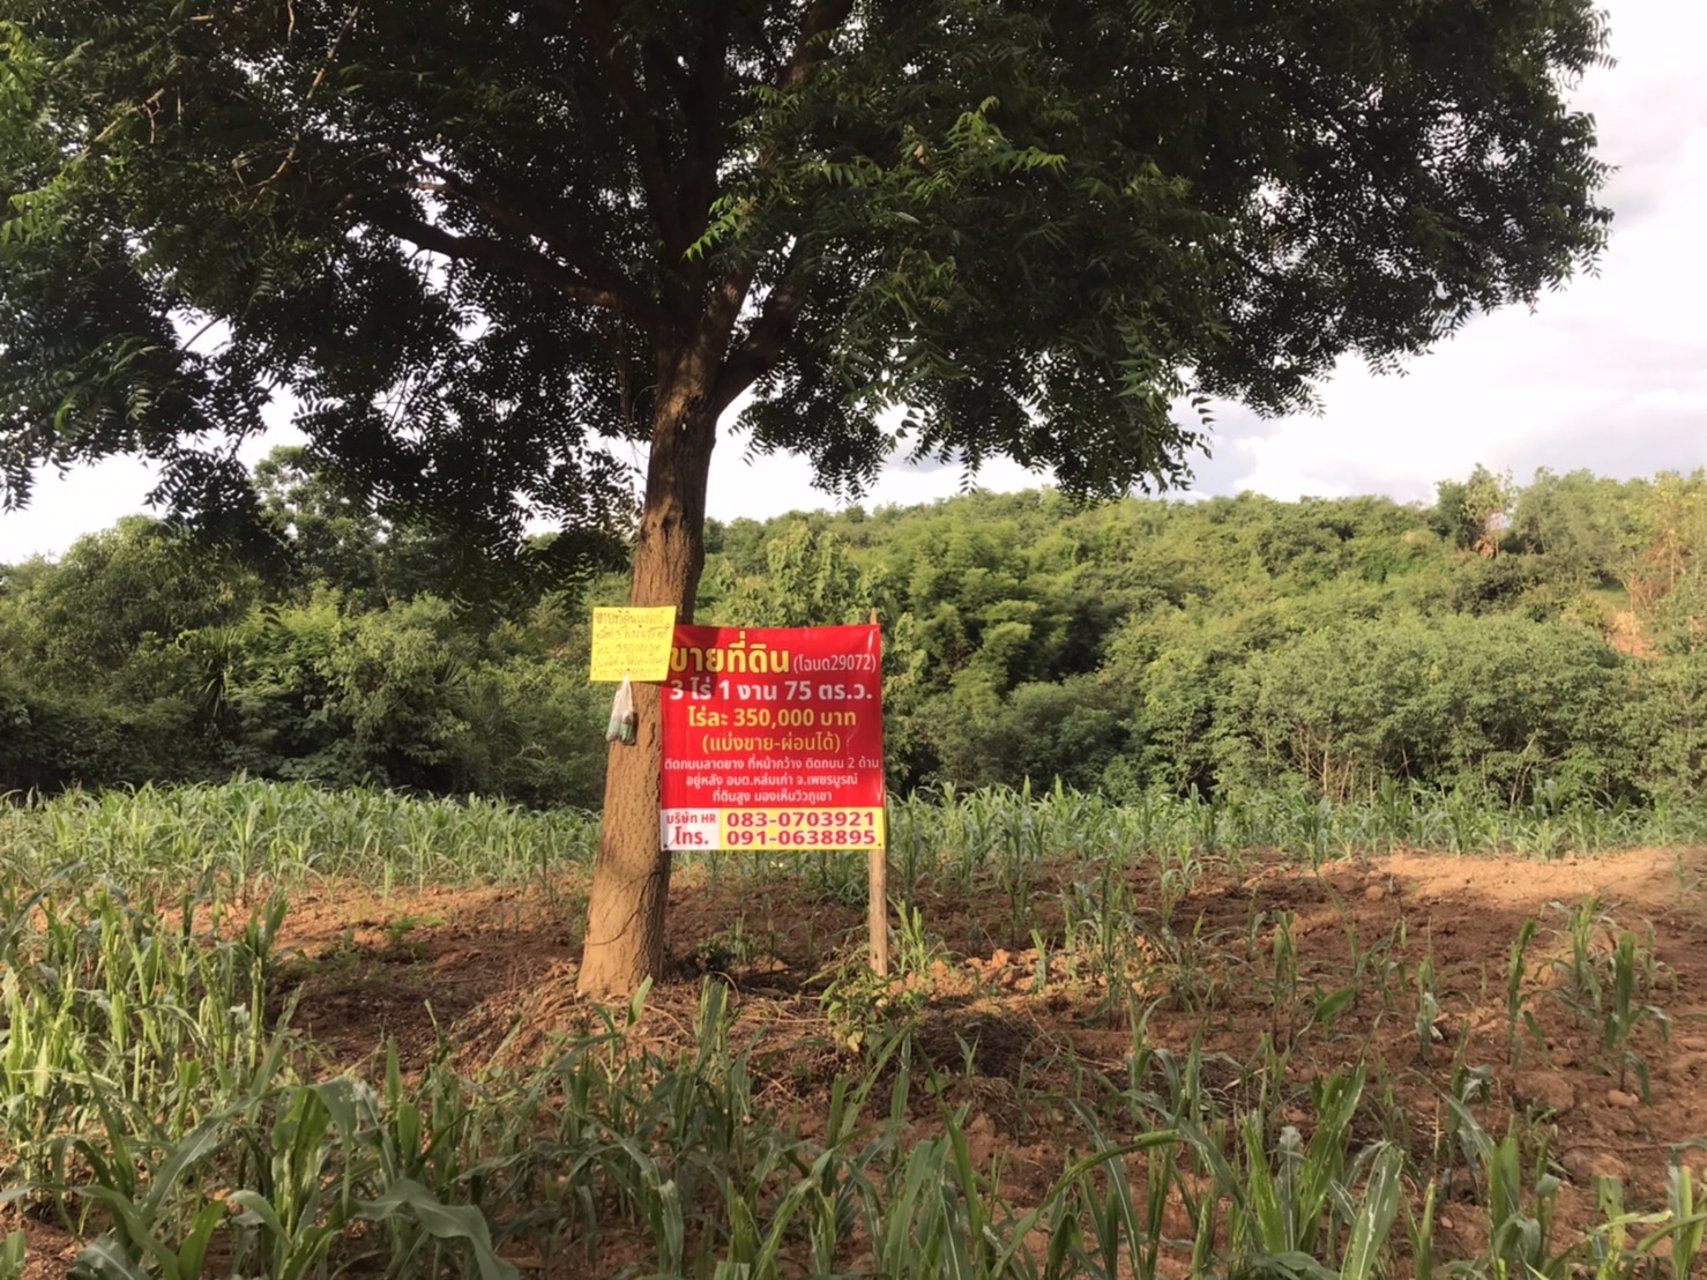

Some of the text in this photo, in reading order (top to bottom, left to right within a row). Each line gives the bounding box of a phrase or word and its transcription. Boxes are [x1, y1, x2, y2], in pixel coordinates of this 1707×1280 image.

[670, 631, 789, 674] ขายที่ดิน
[793, 654, 877, 674] (โฉนด29072)
[670, 678, 872, 700] 3 ไร่ 1 งาน 75 ตร.ว.
[688, 707, 856, 730] ไร่ละ 350,000 บาท
[702, 730, 841, 754] (แบ่งขาย-ผ่อนได้)
[664, 755, 880, 770] ติดถนนลาดยาง ที่หน้ากว้าง ติดถนน 2 ด้าน
[686, 774, 723, 789] อยู่หลัง
[712, 790, 832, 806] ที่ดินสูง มองเห็นวิวภูเขา
[666, 812, 716, 826] บริษัท HR
[726, 812, 874, 828] 083-0703921
[675, 826, 709, 846] โทร.
[726, 830, 876, 846] 091-0638895
